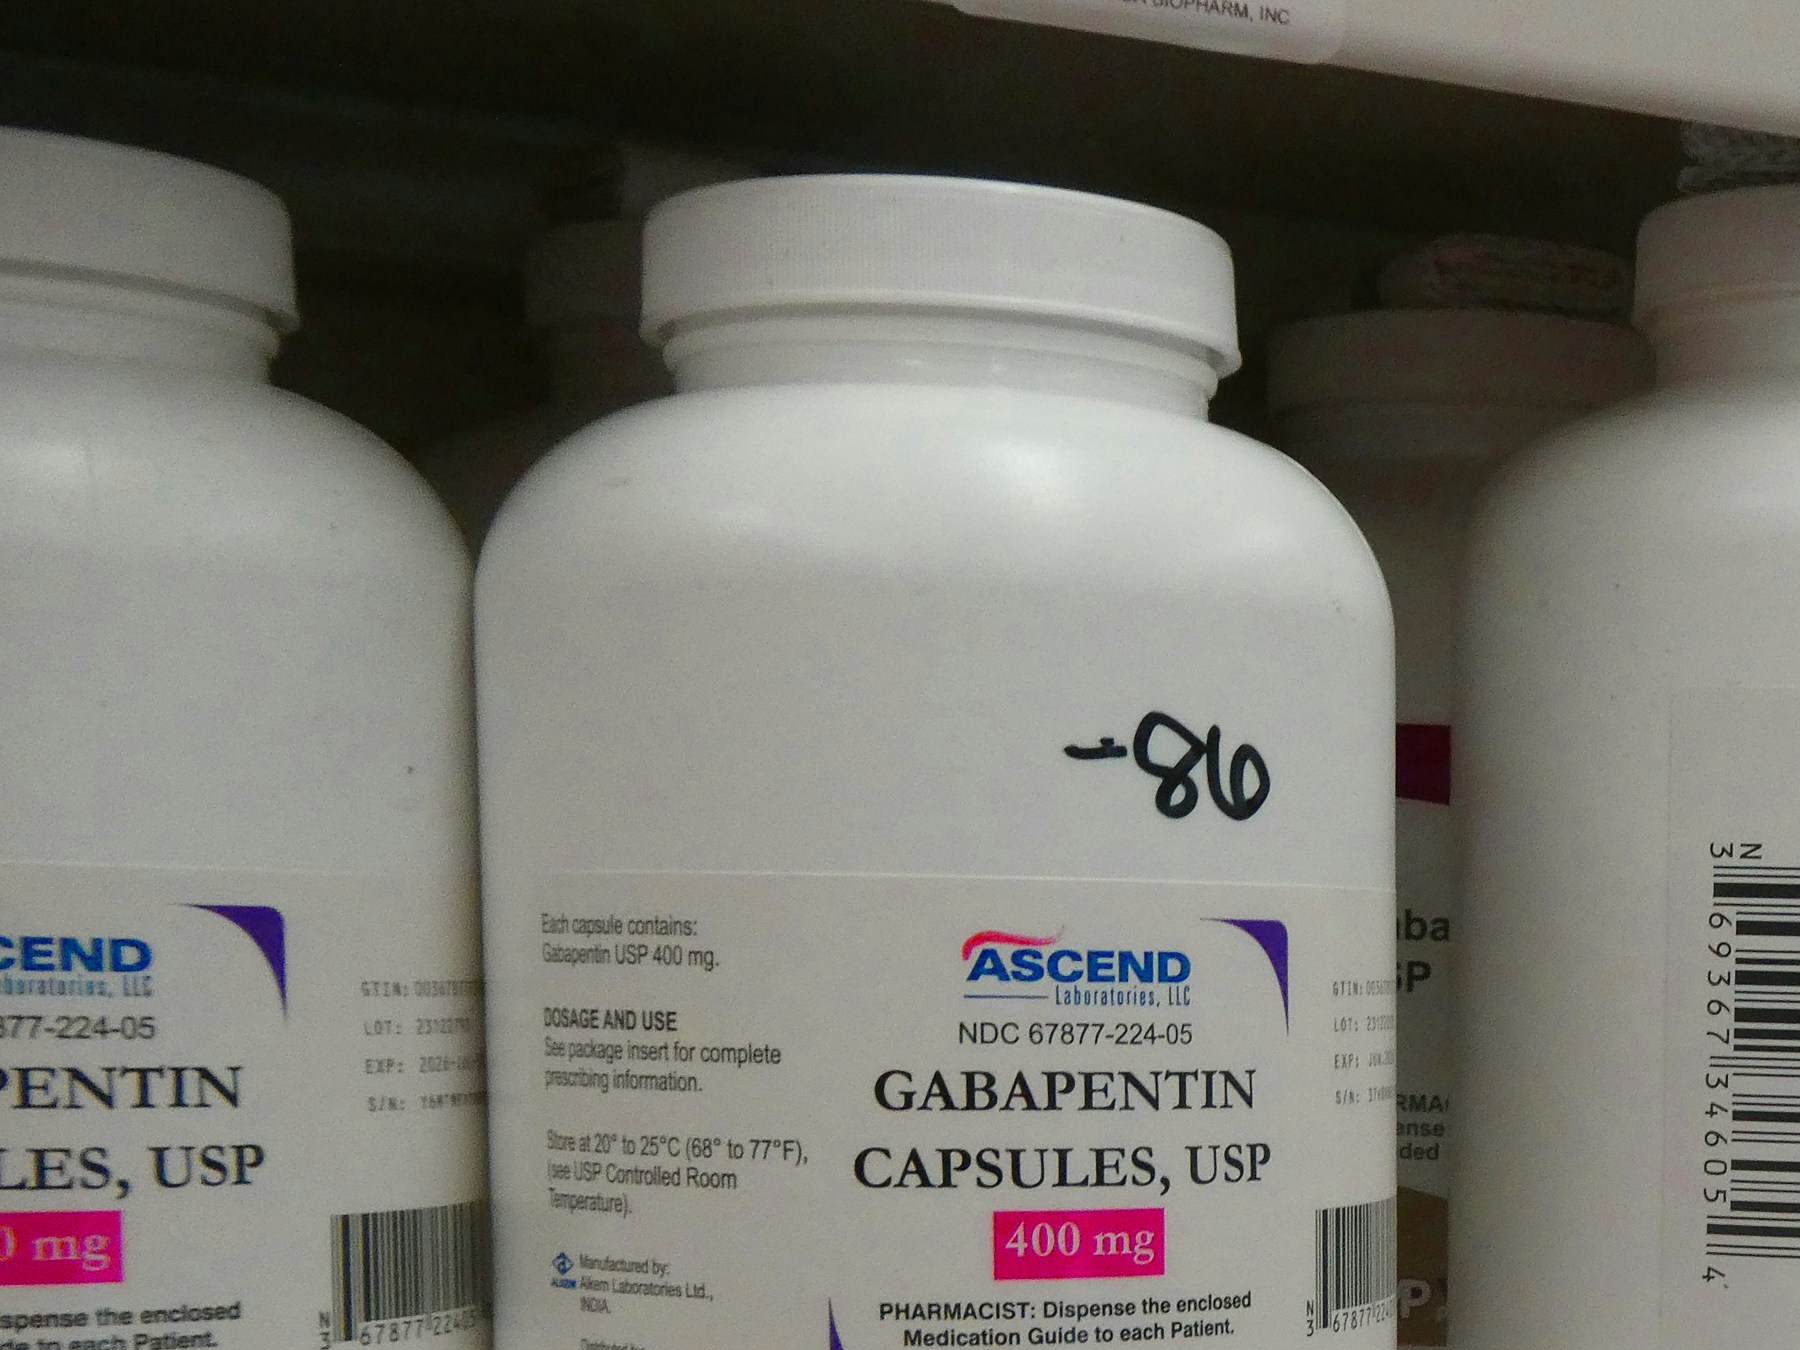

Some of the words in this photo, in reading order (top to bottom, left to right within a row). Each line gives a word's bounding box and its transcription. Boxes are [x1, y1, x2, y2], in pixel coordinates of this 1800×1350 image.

[1259, 5, 1291, 24] INC
[571, 913, 624, 939] capsule
[626, 914, 699, 937] contains:
[542, 942, 612, 968] Gabapentin
[614, 944, 649, 966] USP
[652, 944, 683, 966] 400
[687, 948, 721, 973] mg.
[966, 947, 1192, 984] ASCEND
[1055, 985, 1162, 1008] Laboratories,
[1167, 985, 1191, 1007] LLC
[543, 1007, 600, 1030] DOSAGE
[602, 1008, 638, 1031] AND
[641, 1010, 679, 1032] USE
[958, 1021, 1020, 1046] NDC
[1028, 1021, 1193, 1046] 67877-224-05
[567, 1037, 624, 1065] package
[626, 1040, 670, 1063] insert
[673, 1040, 697, 1063] for
[700, 1042, 782, 1068] complete
[544, 1066, 610, 1094] prescribing
[612, 1068, 704, 1093] information.
[873, 1068, 1258, 1112] GABAPENTIN
[147, 1144, 266, 1188] USP
[639, 1135, 681, 1158] 25°C
[685, 1136, 722, 1163] (68°
[727, 1138, 745, 1161] to
[749, 1138, 809, 1168] 77°F),
[573, 1160, 602, 1183] USP
[605, 1163, 682, 1188] Controlled
[685, 1167, 739, 1190] Room
[853, 1145, 1172, 1196] CAPSULES,
[1184, 1142, 1272, 1185] USP
[31, 1233, 112, 1273] mg
[1004, 1220, 1082, 1258] 400
[1092, 1229, 1155, 1266] mg
[578, 1253, 650, 1275] Manufactured
[611, 1278, 683, 1299] Laboratories
[95, 1306, 134, 1327] the
[139, 1300, 242, 1325] enclosed
[878, 1301, 1037, 1322] PHARMACIST:
[1043, 1300, 1137, 1324] Dispense
[1141, 1296, 1171, 1315] the
[1176, 1290, 1253, 1314] enclosed
[903, 1327, 1022, 1348] Medication
[1027, 1326, 1089, 1347] Guide
[1094, 1325, 1115, 1344] to
[1119, 1322, 1166, 1342] each
[1171, 1318, 1236, 1340] Patient.
